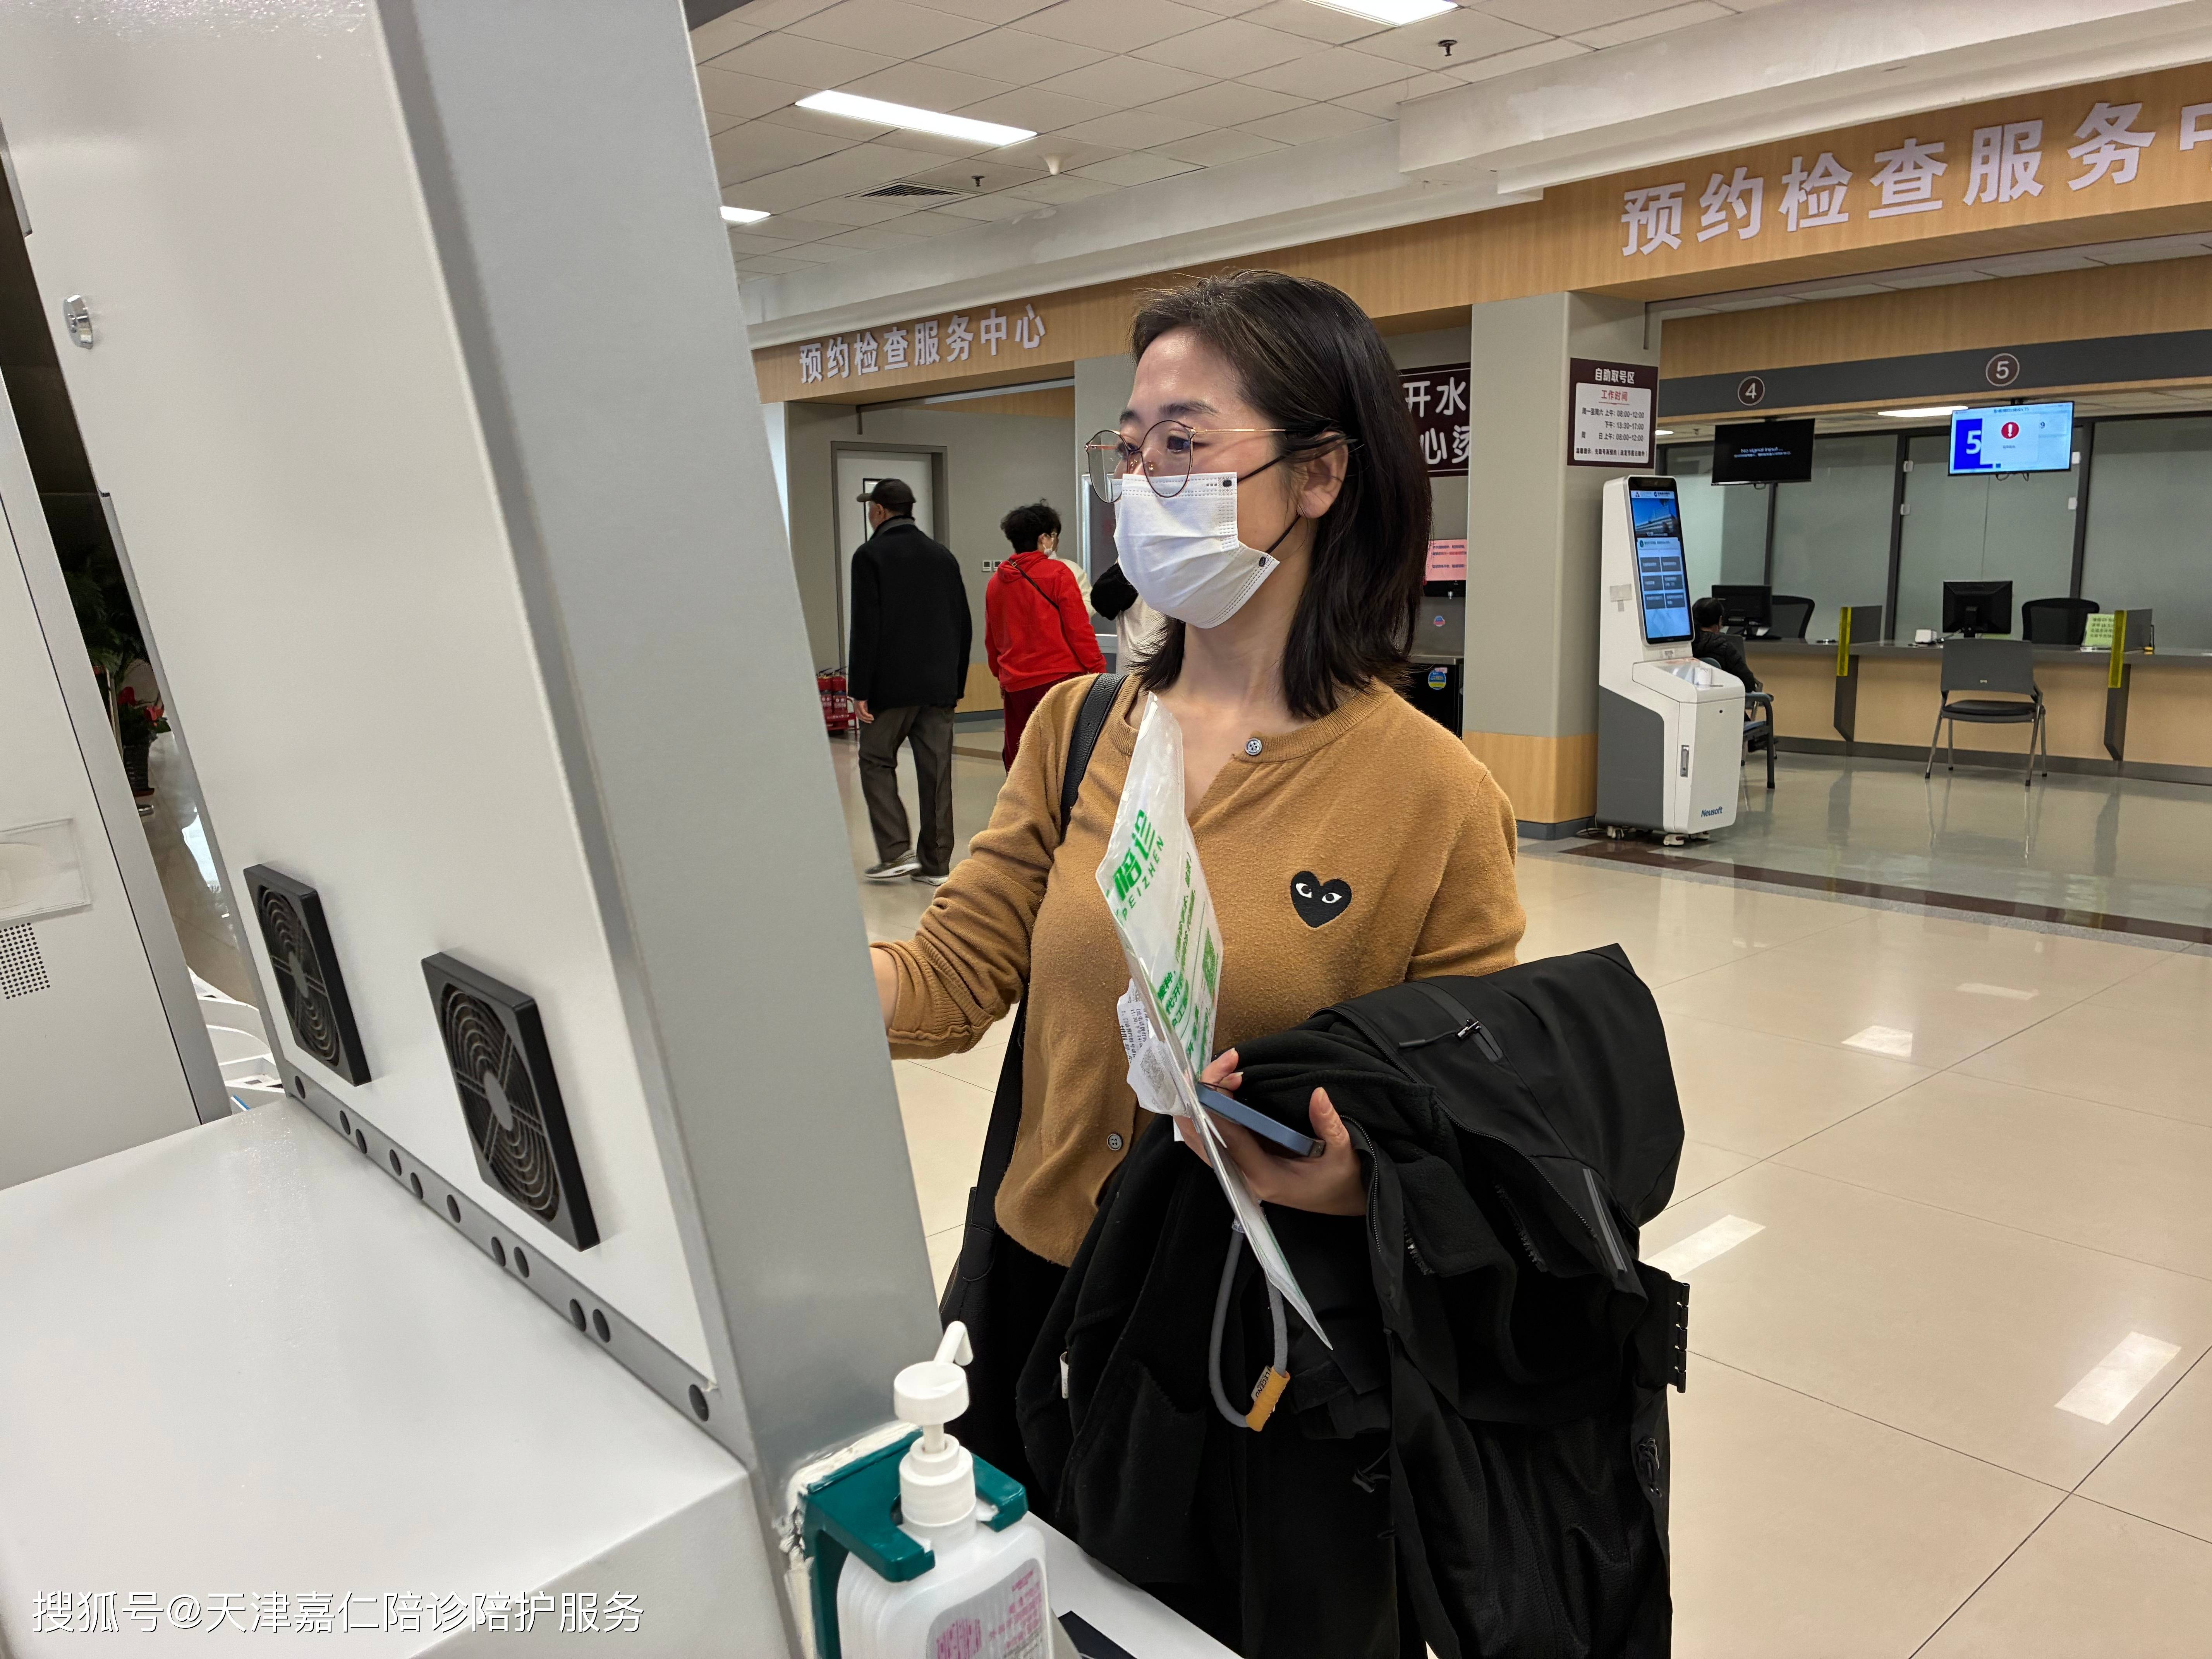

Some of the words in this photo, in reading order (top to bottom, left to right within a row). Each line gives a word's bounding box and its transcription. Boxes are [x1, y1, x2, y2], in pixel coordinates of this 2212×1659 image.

[799, 303, 1046, 384] 预约检查服务中心
[1595, 368, 1635, 384] 自助取号区
[1996, 361, 2009, 379] 5
[1601, 390, 1628, 401] 工作时间
[1745, 382, 1757, 399] 4
[1701, 806, 1723, 818] Neusoft
